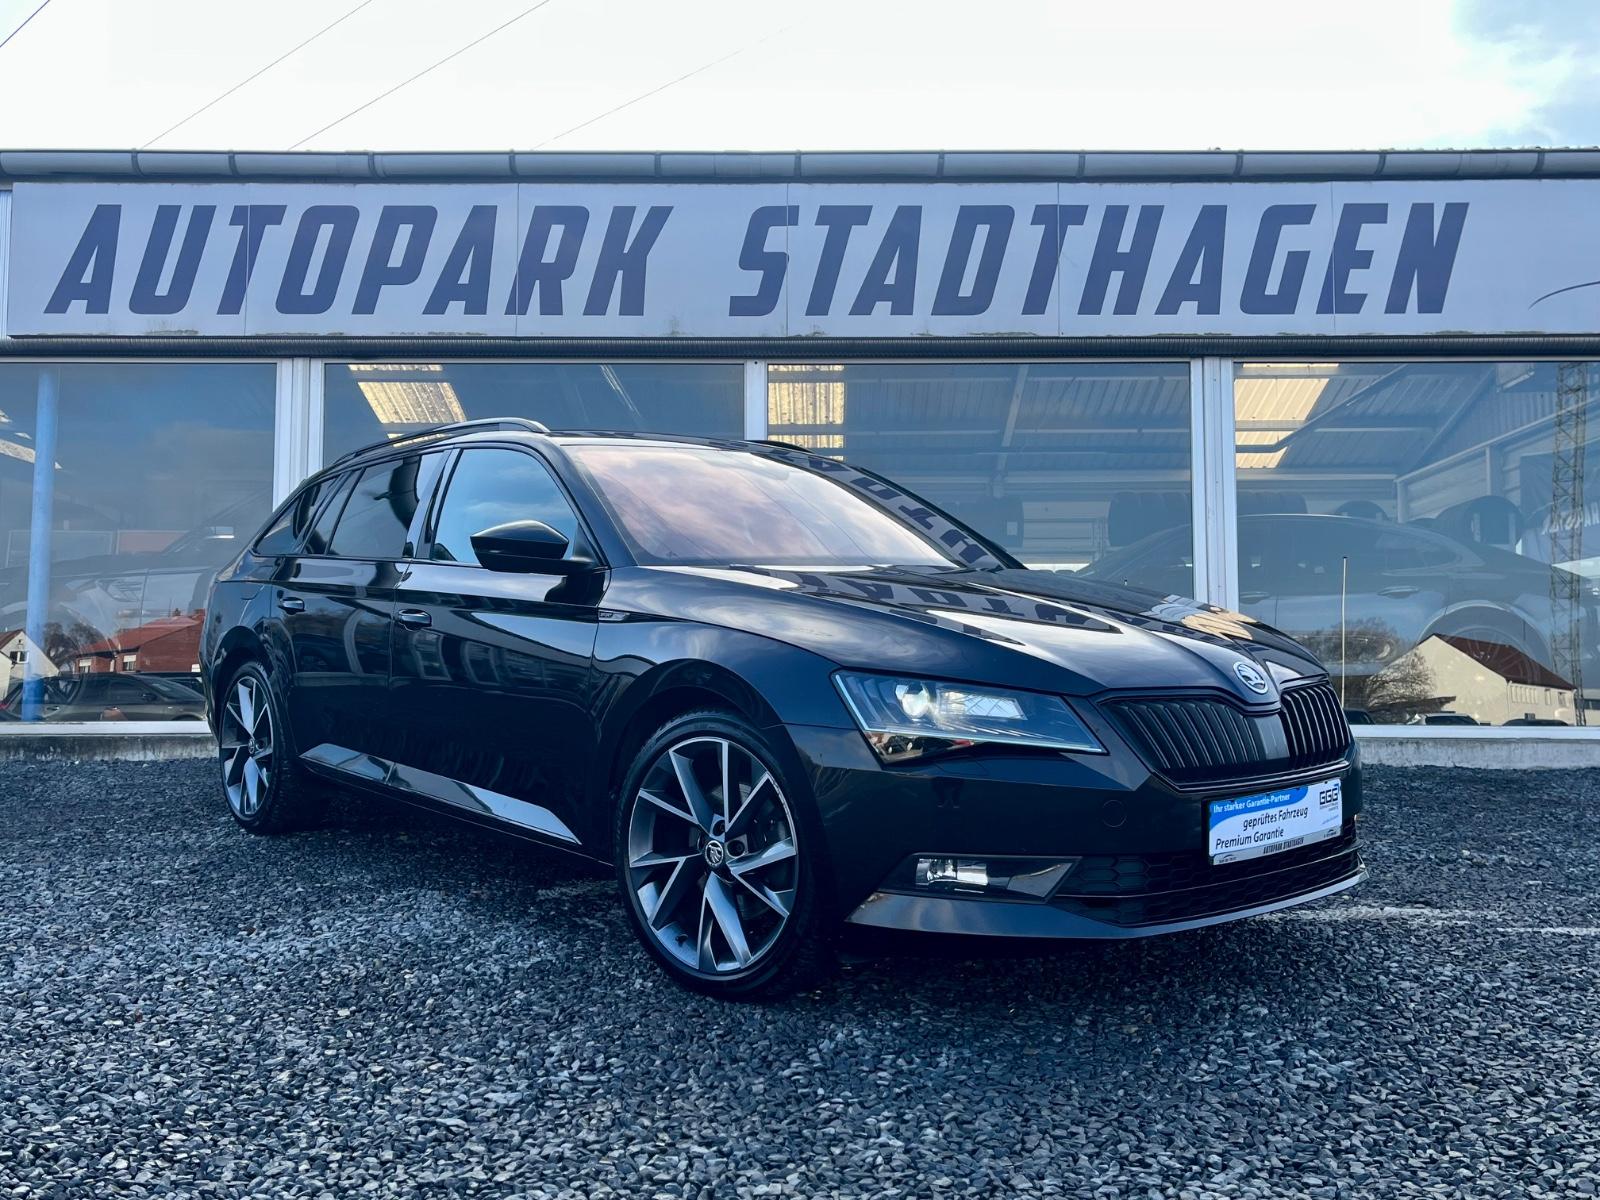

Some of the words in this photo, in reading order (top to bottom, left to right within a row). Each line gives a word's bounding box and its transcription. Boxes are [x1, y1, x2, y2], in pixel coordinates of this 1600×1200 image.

[44, 203, 675, 317] AUTOPARK
[728, 201, 1471, 317] STADTHAGEN
[1213, 805, 1224, 813] Ihr
[1224, 801, 1245, 811] starker
[1246, 794, 1290, 808] Garantie-Partner
[1243, 812, 1277, 831] geprüftes
[1278, 807, 1308, 822] Fahrzeug
[1215, 834, 1252, 849] Premium
[1253, 827, 1284, 843] Garantie
